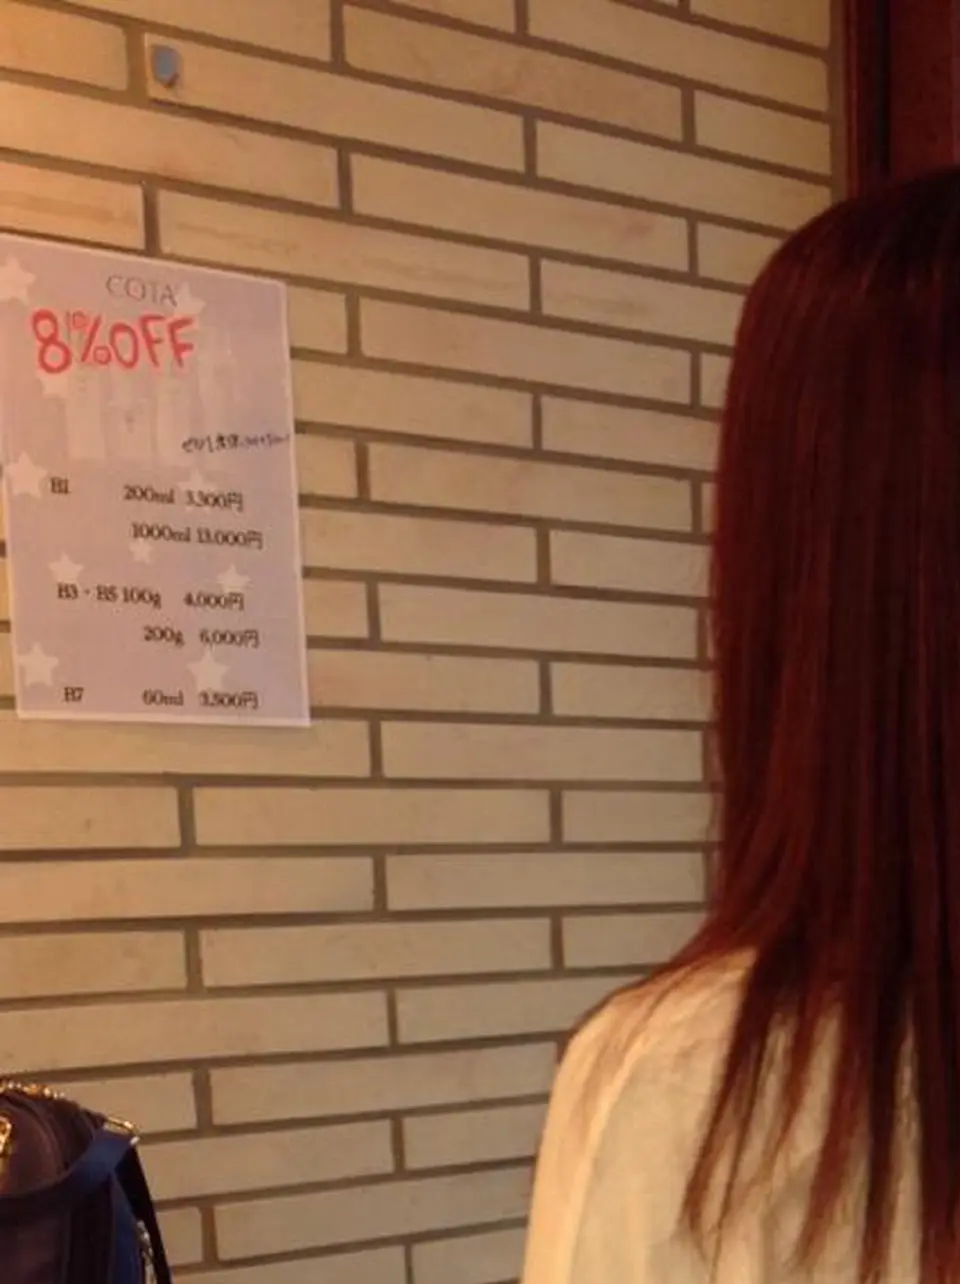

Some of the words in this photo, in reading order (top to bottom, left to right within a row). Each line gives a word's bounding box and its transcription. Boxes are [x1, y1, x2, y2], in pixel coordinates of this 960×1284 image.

[105, 273, 179, 308] COTA
[123, 484, 175, 505] 200ml
[131, 521, 191, 543] 1000ml
[122, 585, 162, 609] 100g
[143, 625, 185, 647] 200g
